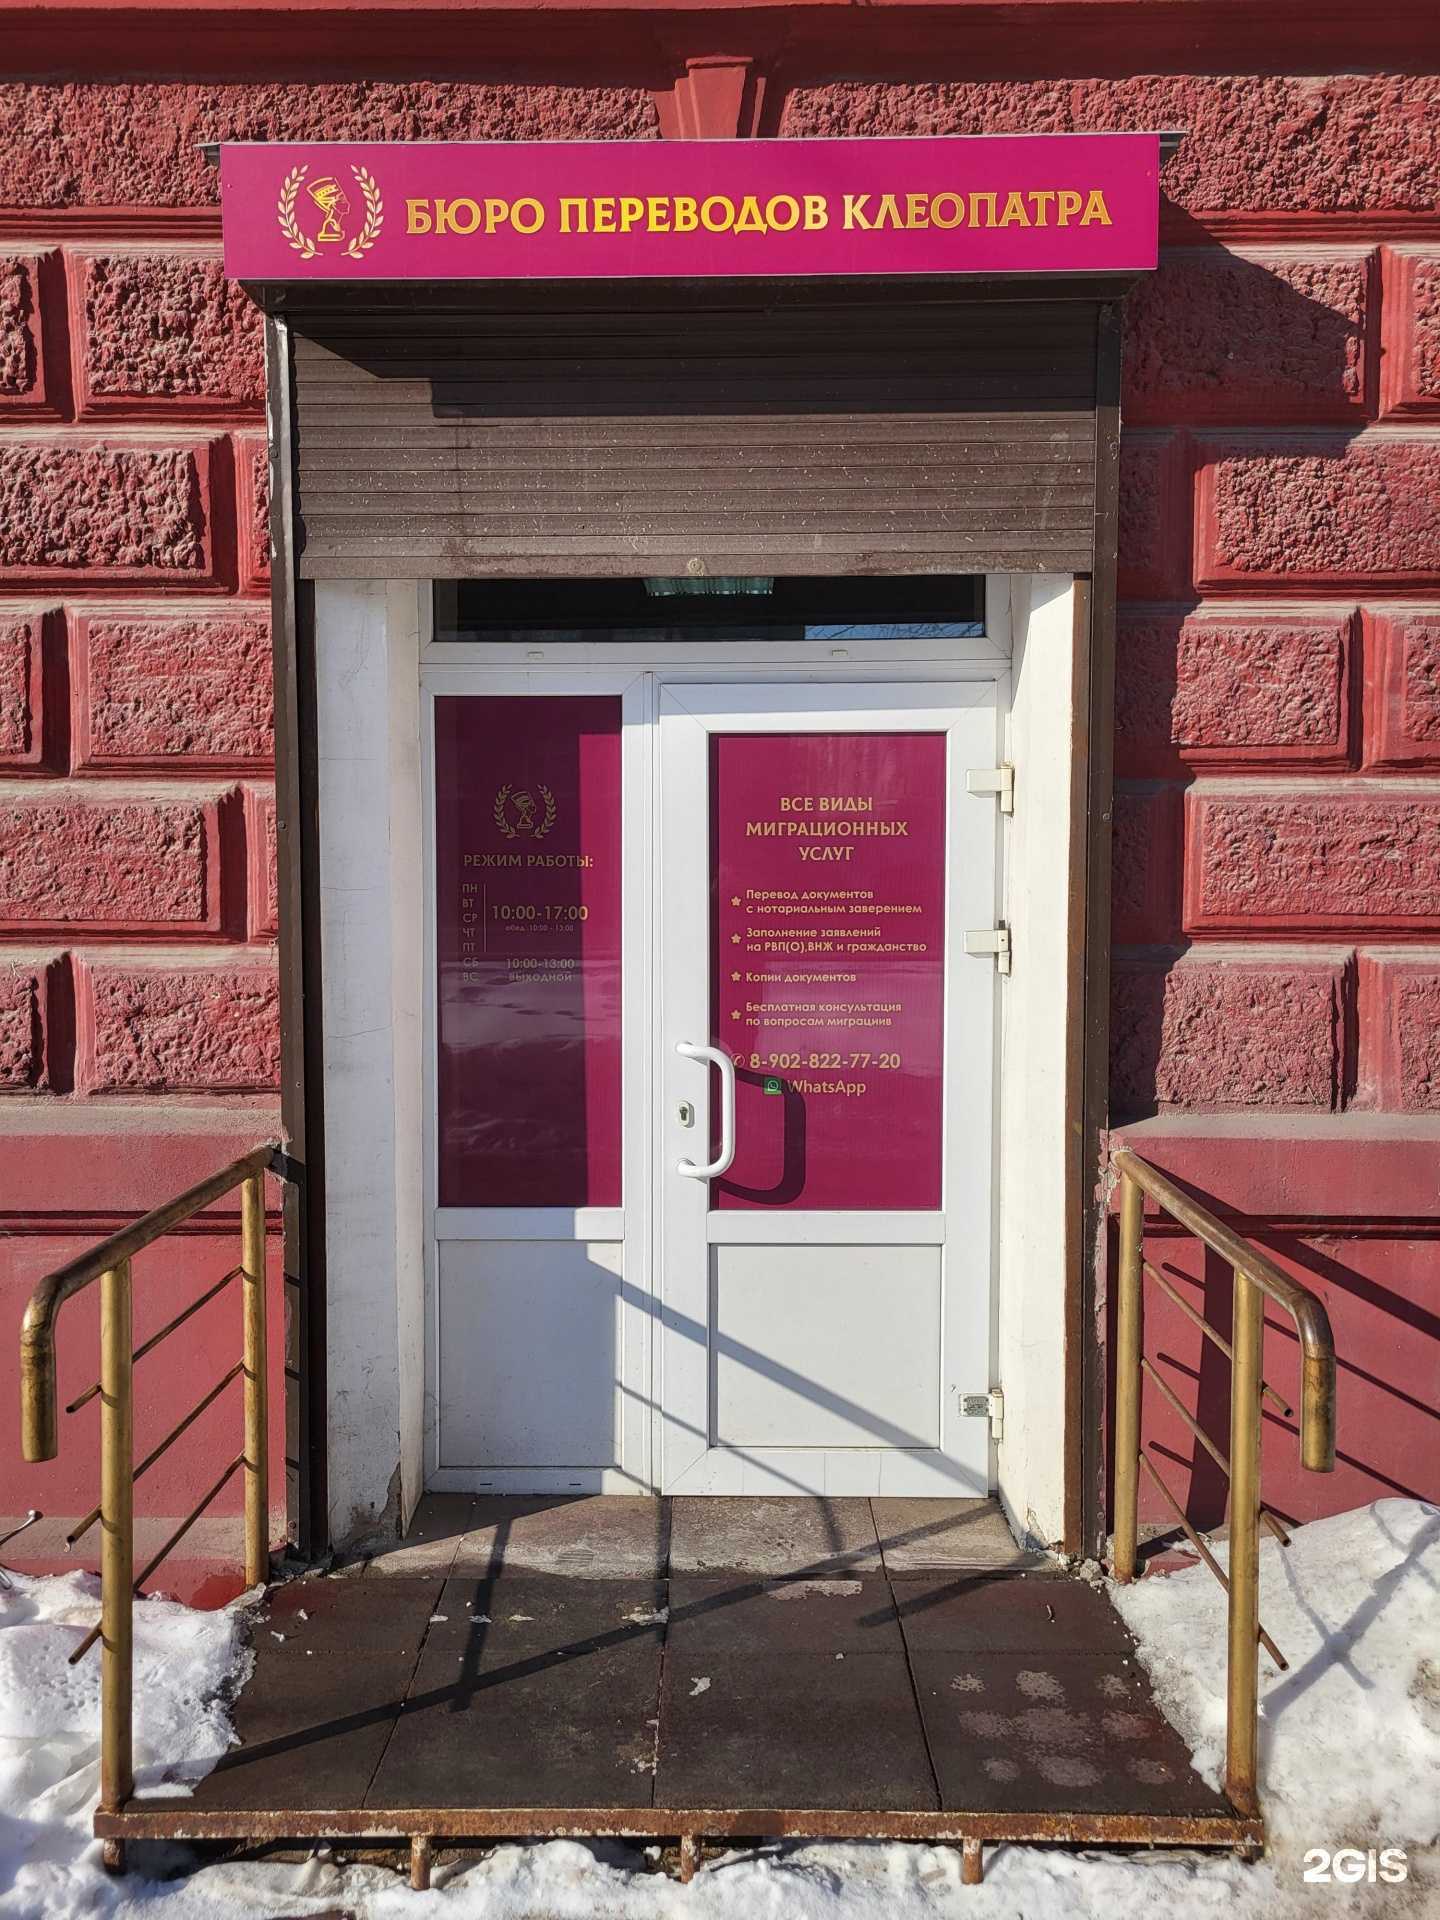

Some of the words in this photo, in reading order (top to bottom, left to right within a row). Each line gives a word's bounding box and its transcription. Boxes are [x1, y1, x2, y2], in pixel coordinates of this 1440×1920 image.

[404, 197, 545, 236] БЮРО
[557, 194, 829, 236] ПЕРЕВОДОВ
[842, 189, 1113, 231] КЛЕОПАТРА
[780, 797, 814, 812] ВСЕ
[818, 797, 874, 813] ВИДЫ
[745, 821, 909, 838] МИГРАЦИОННЫХ
[798, 846, 855, 861] УСЛУГ
[464, 854, 522, 867] РЕЖИМ
[527, 854, 594, 867] РАБОТЫ:
[462, 883, 478, 894] ПН
[746, 889, 798, 902] Перевод
[801, 890, 874, 902] документов
[462, 898, 475, 909] ВТ
[492, 905, 589, 921] 10:00-17:00
[746, 905, 754, 914] с
[756, 905, 846, 915] нотариальным
[849, 905, 922, 916] заверением
[462, 913, 479, 924] СР
[462, 927, 476, 938] ЧТ
[746, 927, 818, 938] Заполнение
[820, 926, 881, 938] заявлений
[462, 942, 476, 953] ПТ
[746, 943, 762, 952] на
[836, 943, 844, 952] и
[846, 943, 927, 955] гражданство
[746, 972, 782, 982] Копии
[784, 973, 857, 984] документов
[746, 1001, 817, 1013] Бесплатная
[818, 1003, 902, 1014] консультация
[746, 1018, 761, 1027] по
[764, 1018, 824, 1028] вопросам
[750, 1053, 901, 1069] 8-902-822-77-20
[788, 1080, 867, 1096] WhatsApp
